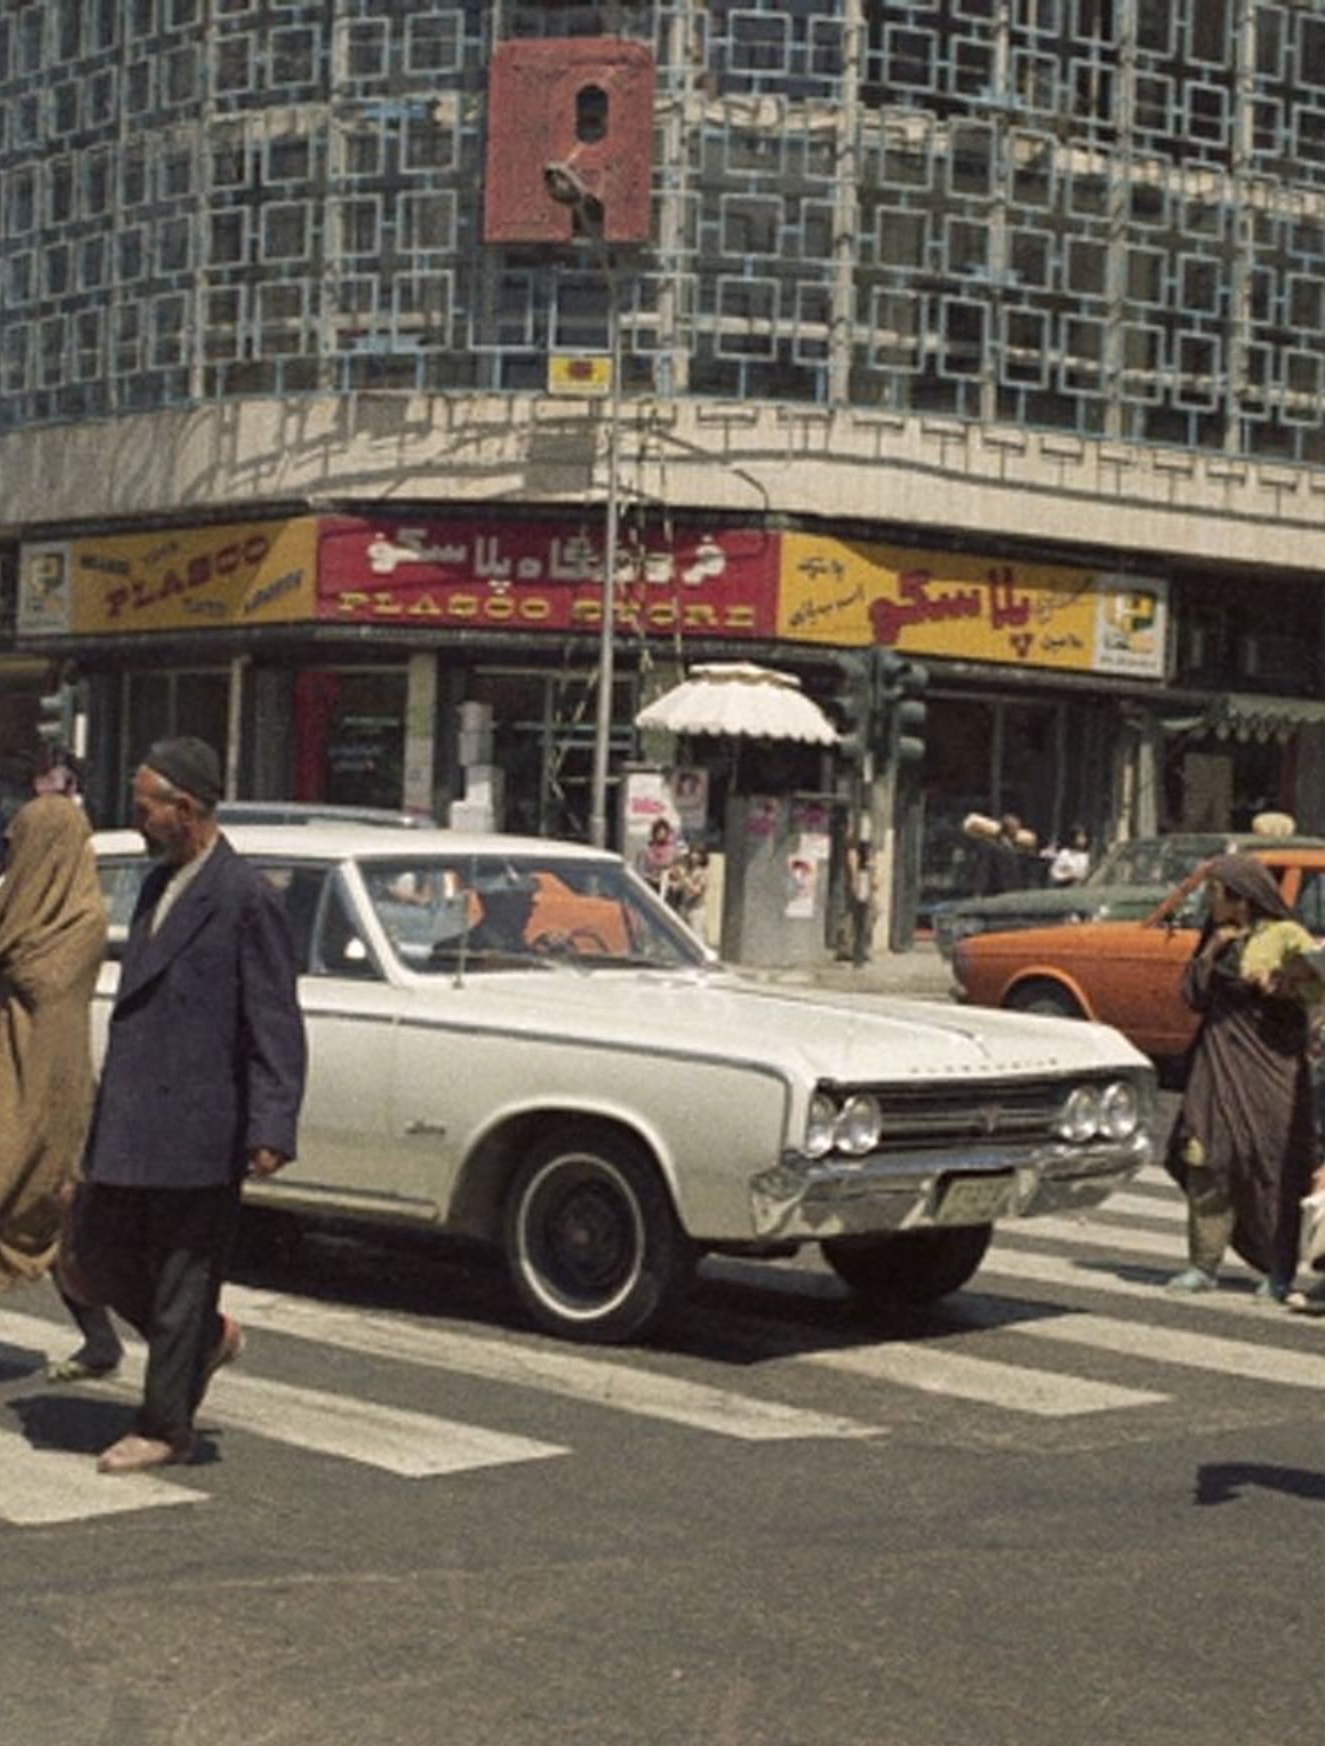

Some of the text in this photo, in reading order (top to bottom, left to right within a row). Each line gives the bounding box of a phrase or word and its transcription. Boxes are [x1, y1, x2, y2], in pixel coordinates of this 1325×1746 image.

[104, 534, 268, 618] PLASCO
[339, 591, 551, 620] PLASCO
[868, 567, 1033, 658] پلاسکو
